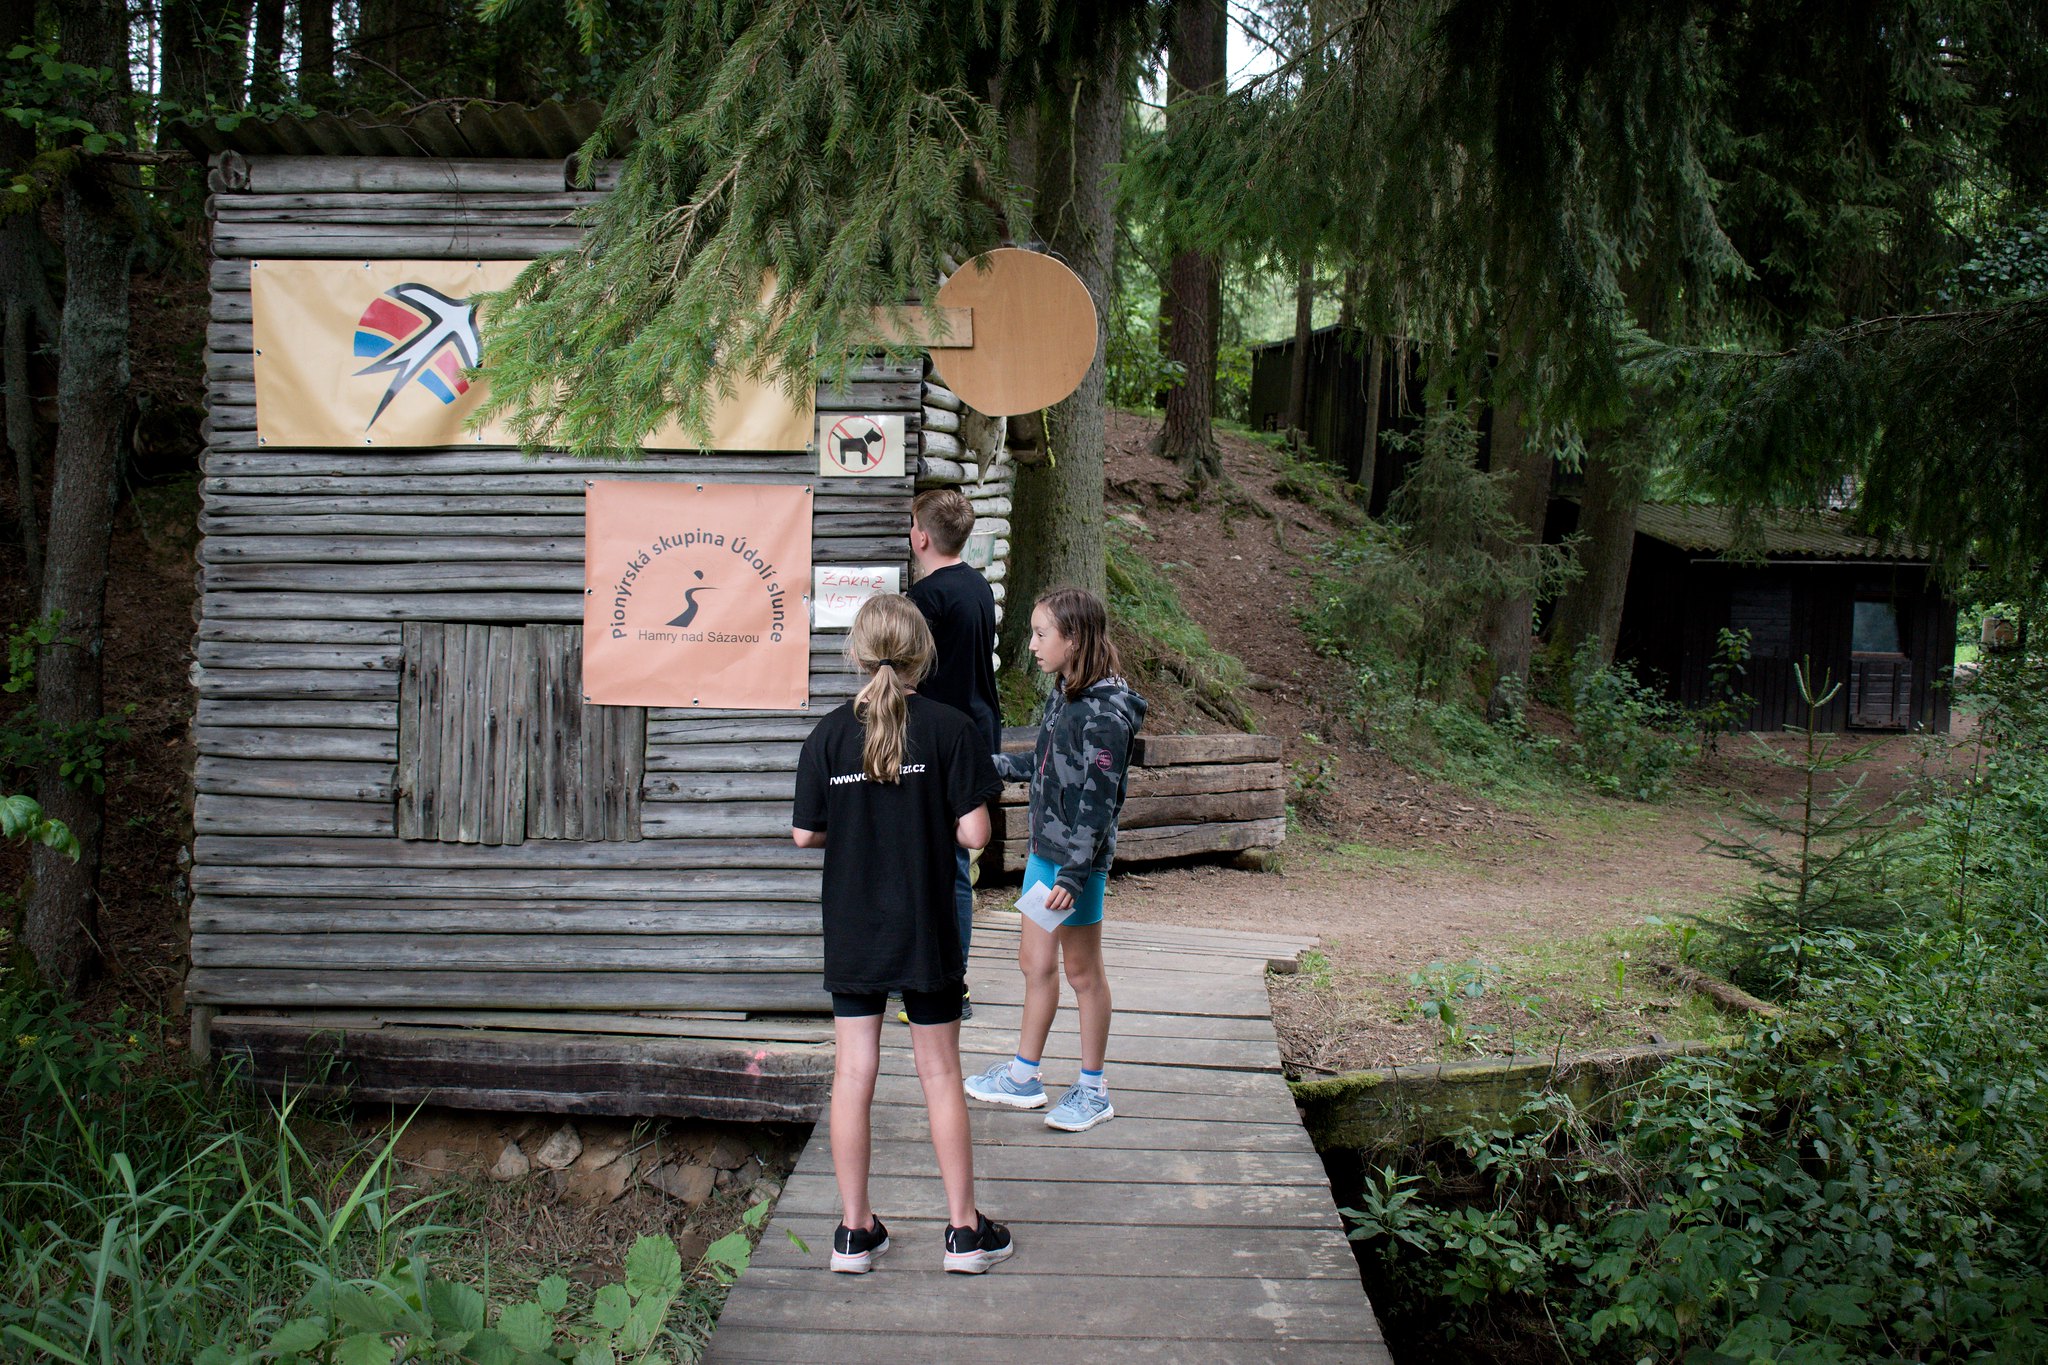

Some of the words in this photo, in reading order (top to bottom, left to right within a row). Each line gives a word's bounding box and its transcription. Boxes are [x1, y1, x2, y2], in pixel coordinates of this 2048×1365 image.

[610, 549, 652, 640] Pionýrská
[652, 528, 725, 555] skupina
[731, 536, 777, 580] Údolí
[767, 582, 786, 643] slunce
[638, 629, 678, 644] Hamry
[681, 631, 704, 642] nad
[707, 631, 760, 643] Sázavou
